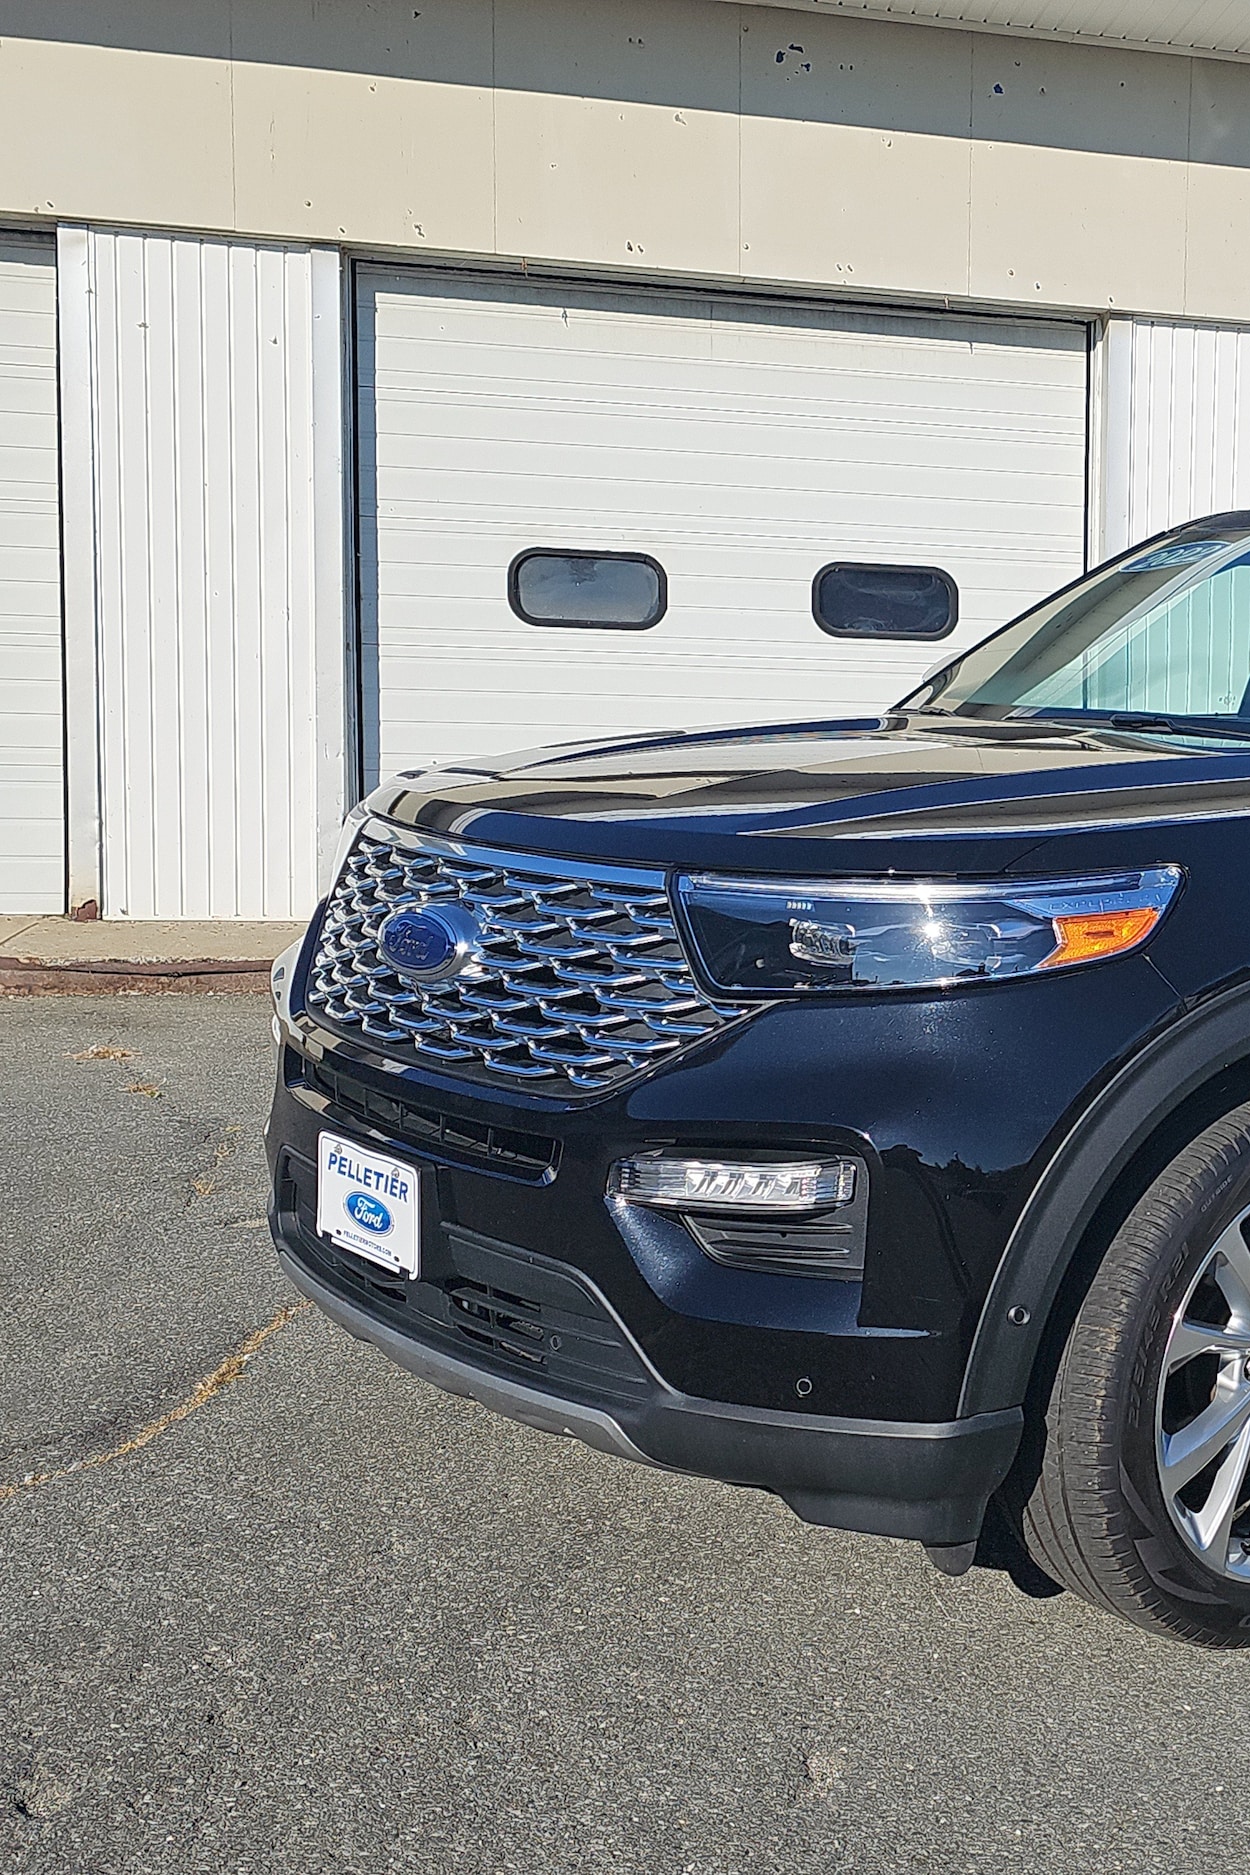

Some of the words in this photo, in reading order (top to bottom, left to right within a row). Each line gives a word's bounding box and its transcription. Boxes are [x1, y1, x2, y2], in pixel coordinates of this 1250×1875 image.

[327, 1152, 410, 1204] PELLETIER
[1200, 1173, 1234, 1213] OUTSIDE
[354, 1197, 384, 1230] Ford
[1128, 1303, 1162, 1429] 275/45
[1159, 1241, 1190, 1303] R21
